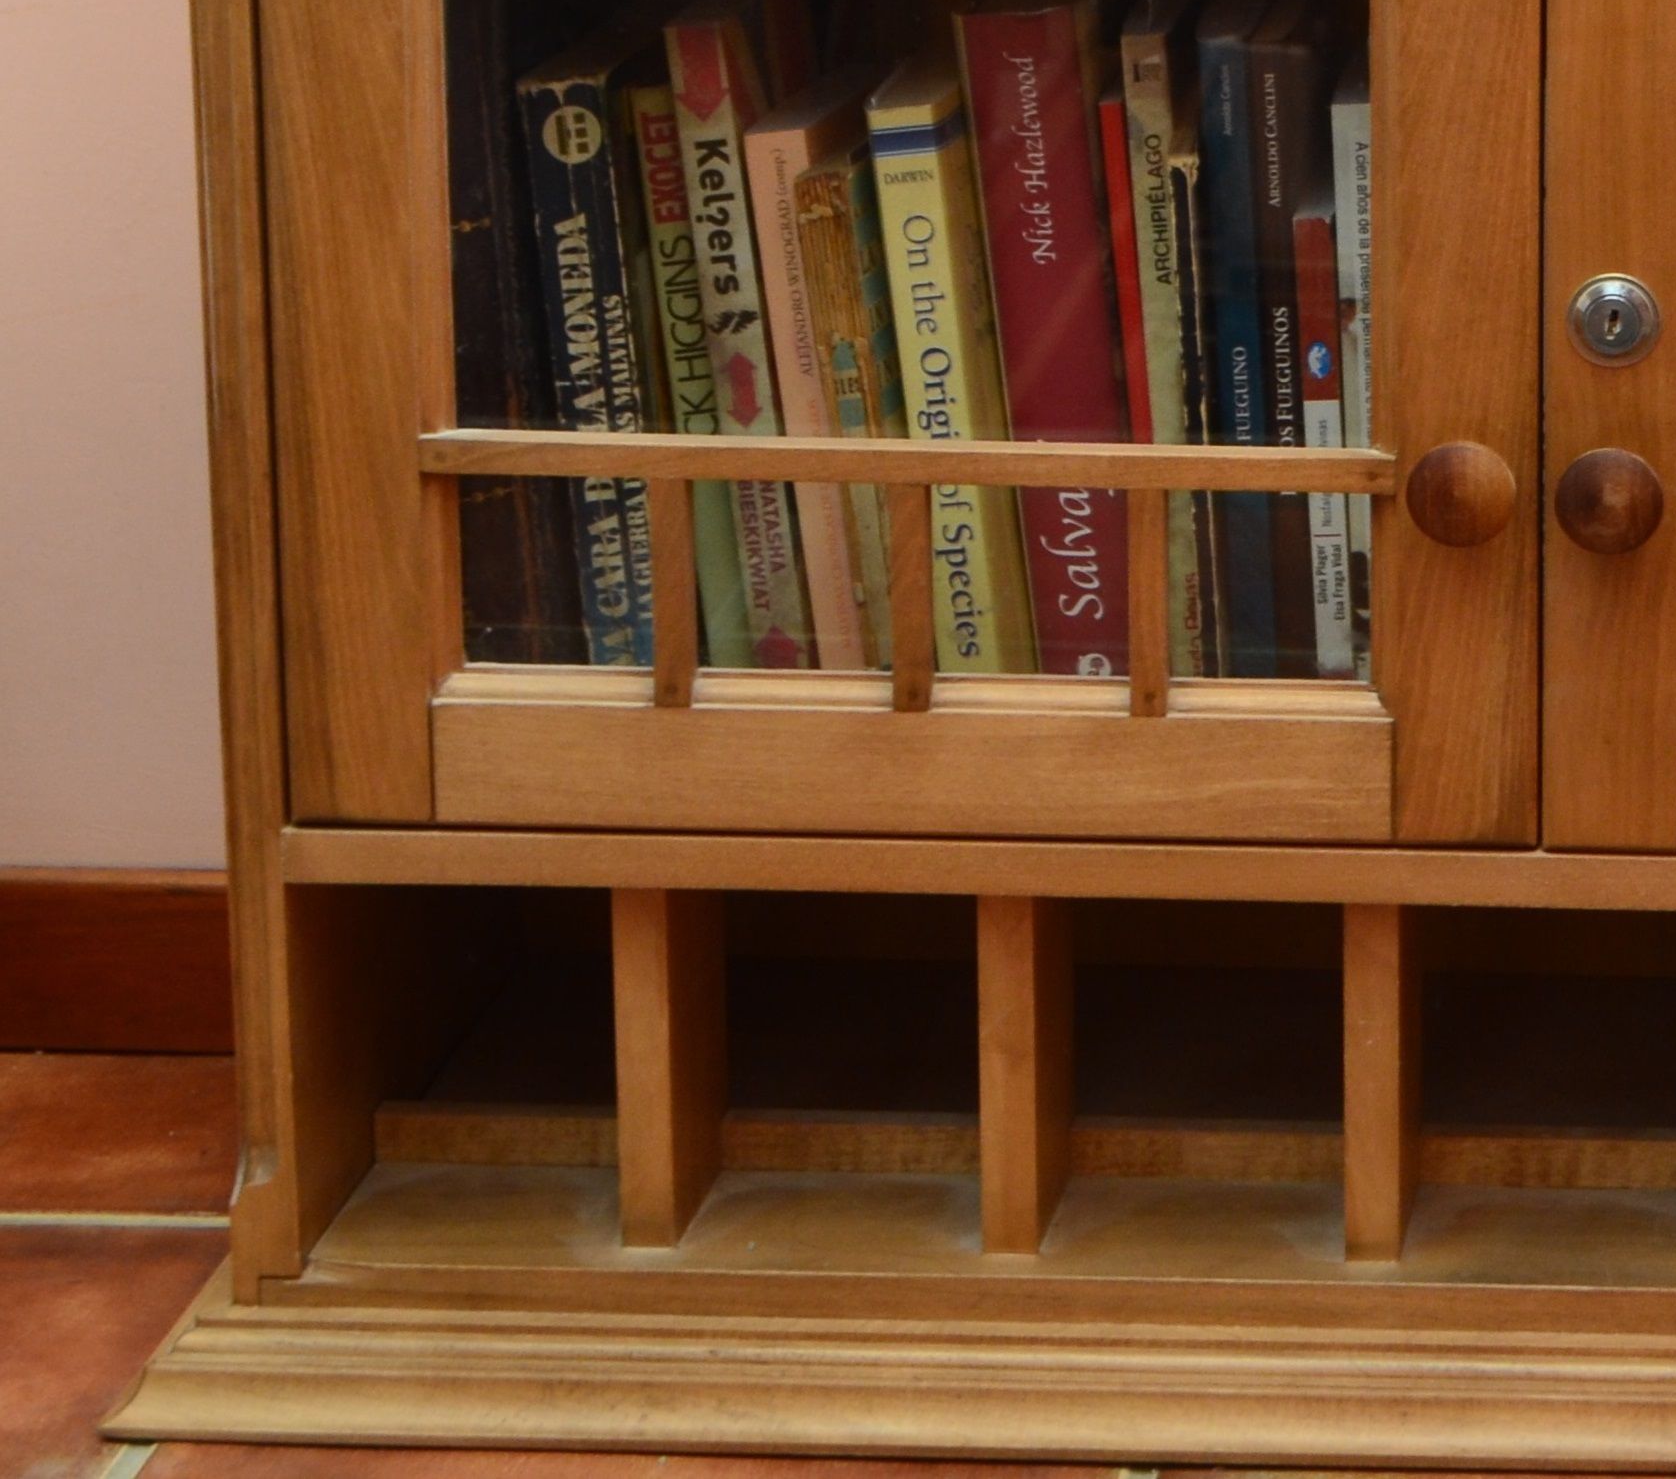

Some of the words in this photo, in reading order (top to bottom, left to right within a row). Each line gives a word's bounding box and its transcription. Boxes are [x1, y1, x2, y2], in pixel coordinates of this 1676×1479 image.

[999, 47, 1051, 195] Hazlewood
[1260, 72, 1278, 138] CANCLINI
[639, 110, 689, 224] EXOCET
[883, 169, 934, 185] DARWIN
[1141, 133, 1173, 286] ARCHIPIÉLAGO
[1263, 140, 1282, 208] ARNOLDO
[1355, 153, 1368, 179] cien
[1355, 183, 1371, 214] años
[775, 199, 800, 286] WINOGRAD
[901, 213, 938, 268] On
[1017, 198, 1059, 266] Nick
[549, 211, 605, 377] MONEDA
[659, 234, 702, 382] HIGGINS
[789, 288, 813, 378] ALEJANDRO
[909, 279, 949, 335] the
[602, 295, 632, 404] MALVINAS
[1228, 345, 1254, 441] FUEGUINO
[1268, 305, 1296, 421] FUEGUINOS
[586, 513, 632, 619] CARA
[624, 494, 654, 588] GUERRA
[736, 478, 770, 612] BIESKIKWIAT
[758, 480, 787, 573] NATASHA
[1031, 486, 1112, 628] Salva
[1329, 544, 1343, 566] Vidal
[932, 522, 989, 663] Species
[1315, 579, 1329, 604] Silvia
[1331, 570, 1345, 598] Fraga
[1332, 601, 1344, 620] Elsa
